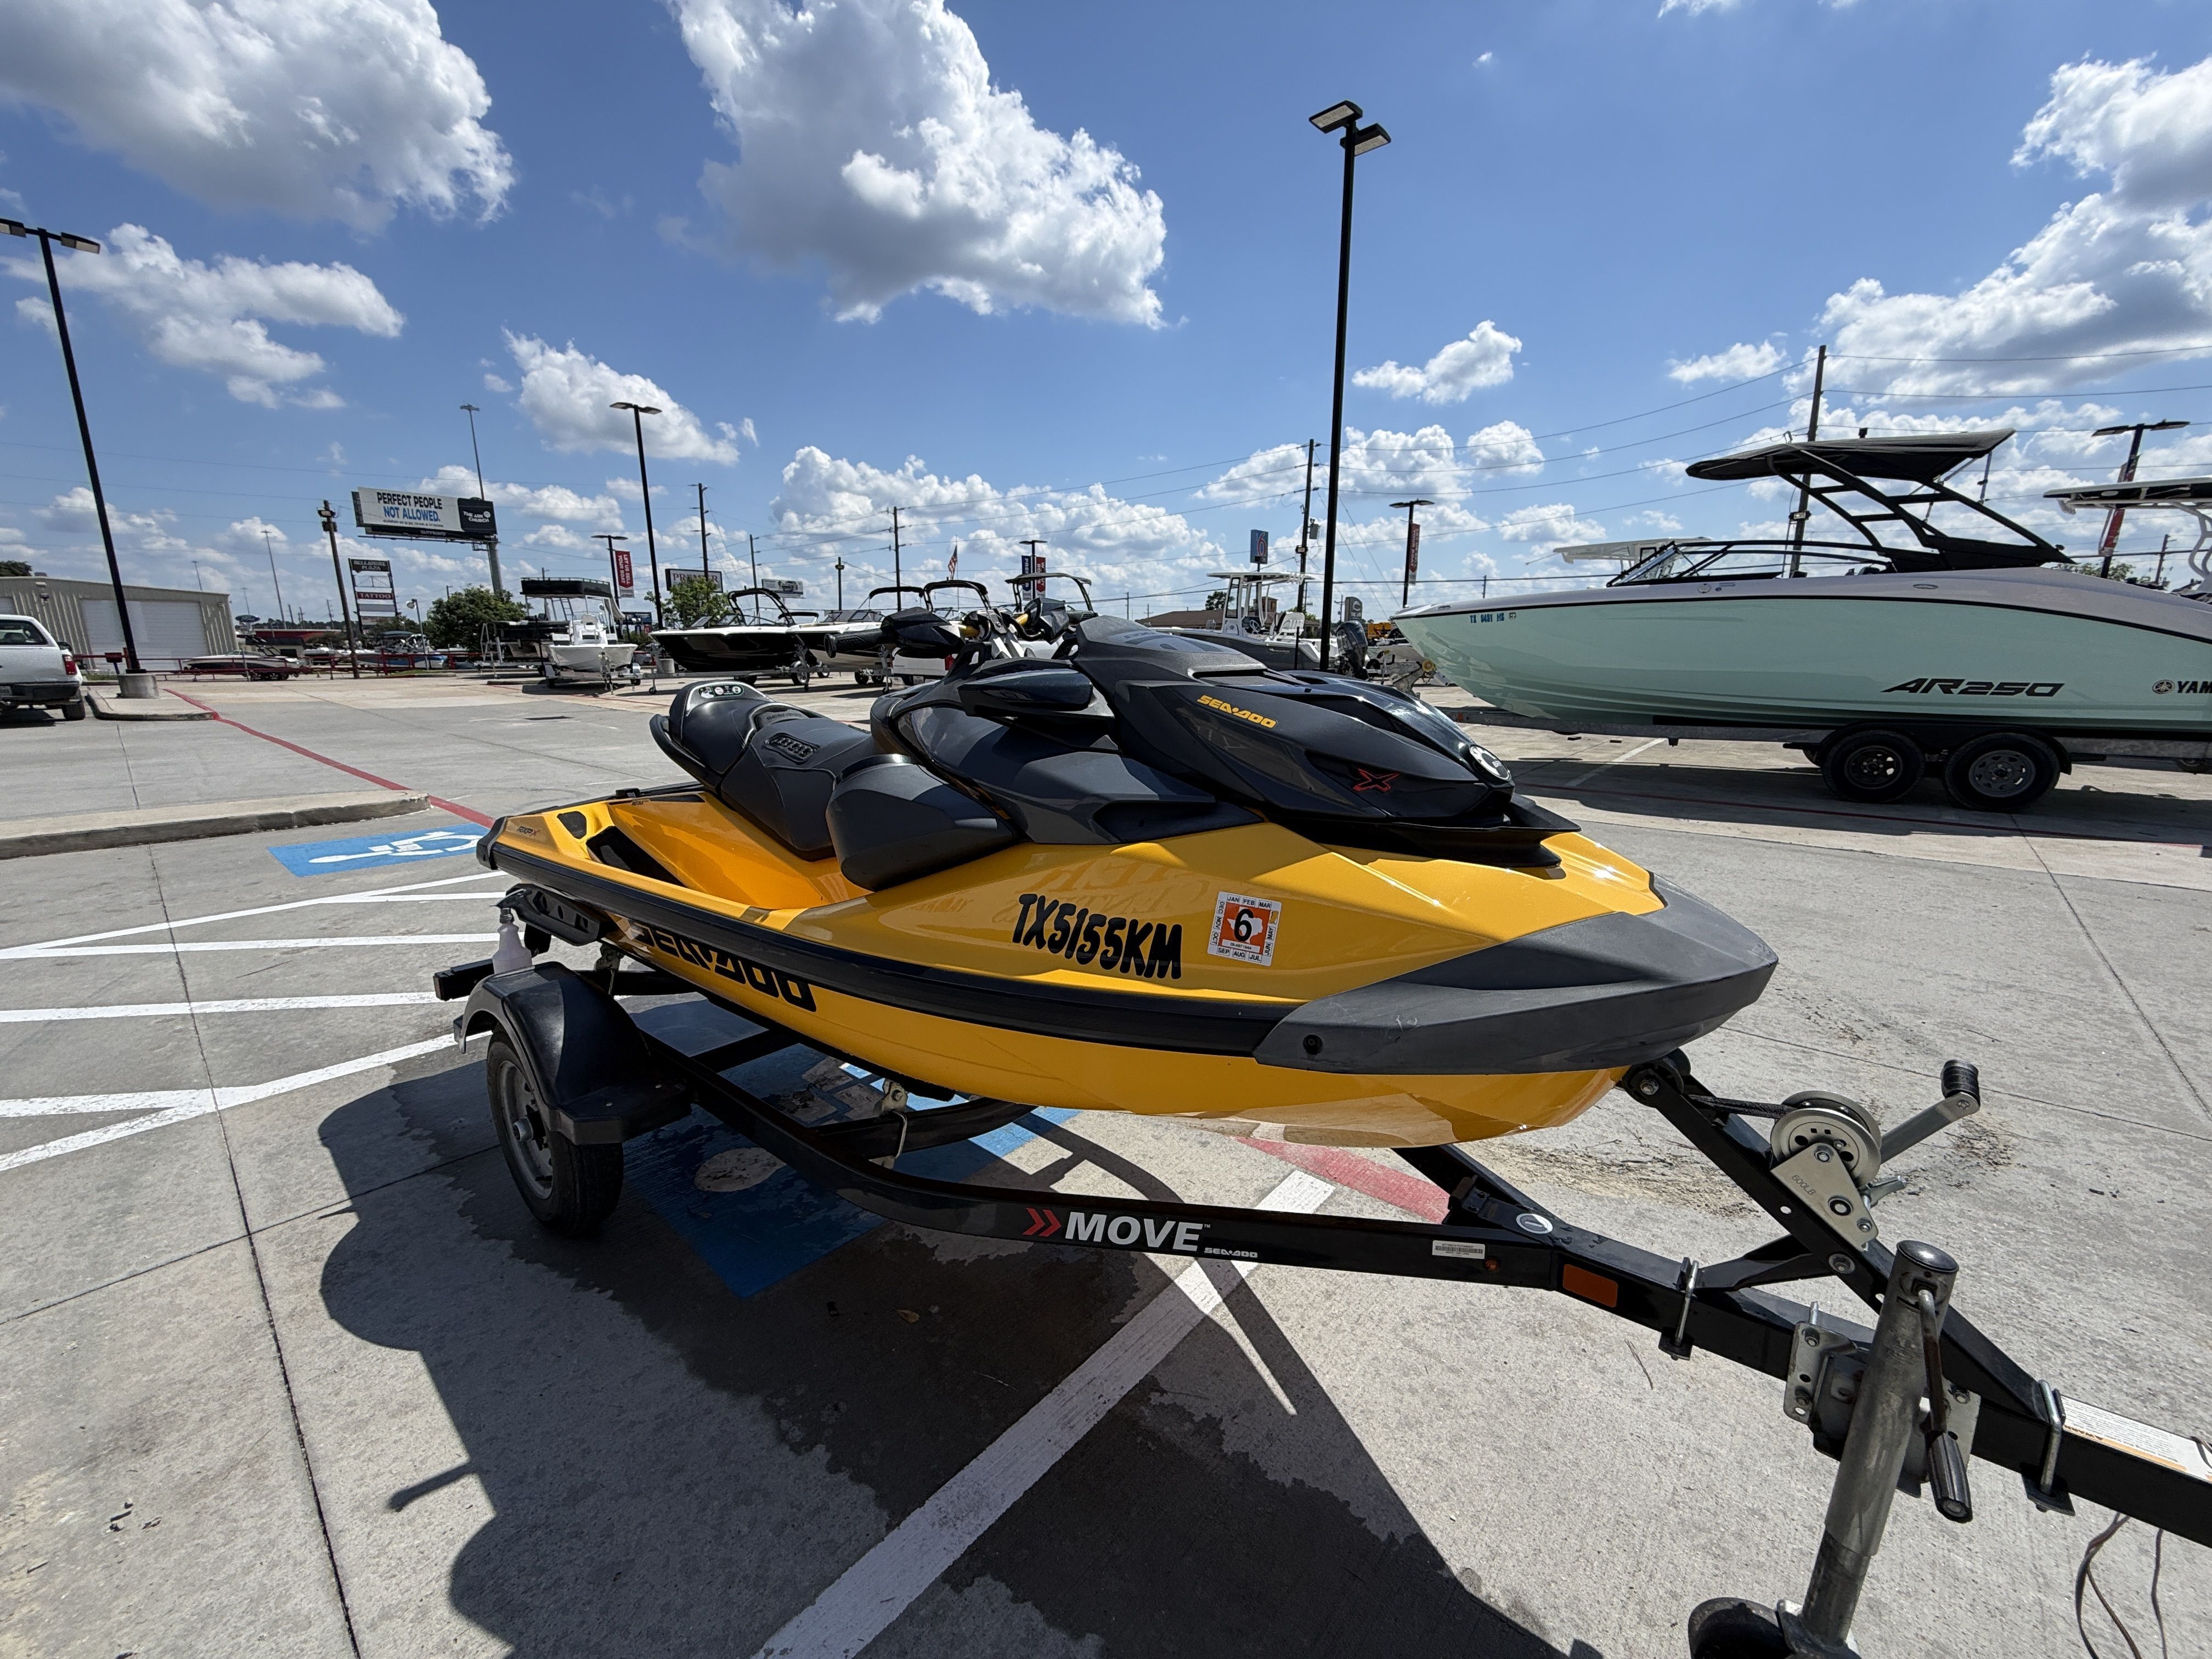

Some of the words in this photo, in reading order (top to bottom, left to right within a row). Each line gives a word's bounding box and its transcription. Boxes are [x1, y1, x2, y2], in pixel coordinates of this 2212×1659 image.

[377, 492, 411, 506] PERFECT
[414, 495, 443, 510] PEOPLE
[383, 506, 400, 518] NOT
[403, 508, 441, 522] ALLOWED.
[1257, 532, 1267, 556] 6
[1470, 614, 1477, 623] TX
[1881, 678, 2065, 697] AR250
[1234, 909, 1254, 942] 6
[1012, 893, 1183, 980] TX5155KM
[1065, 1211, 1203, 1252] MOVE
